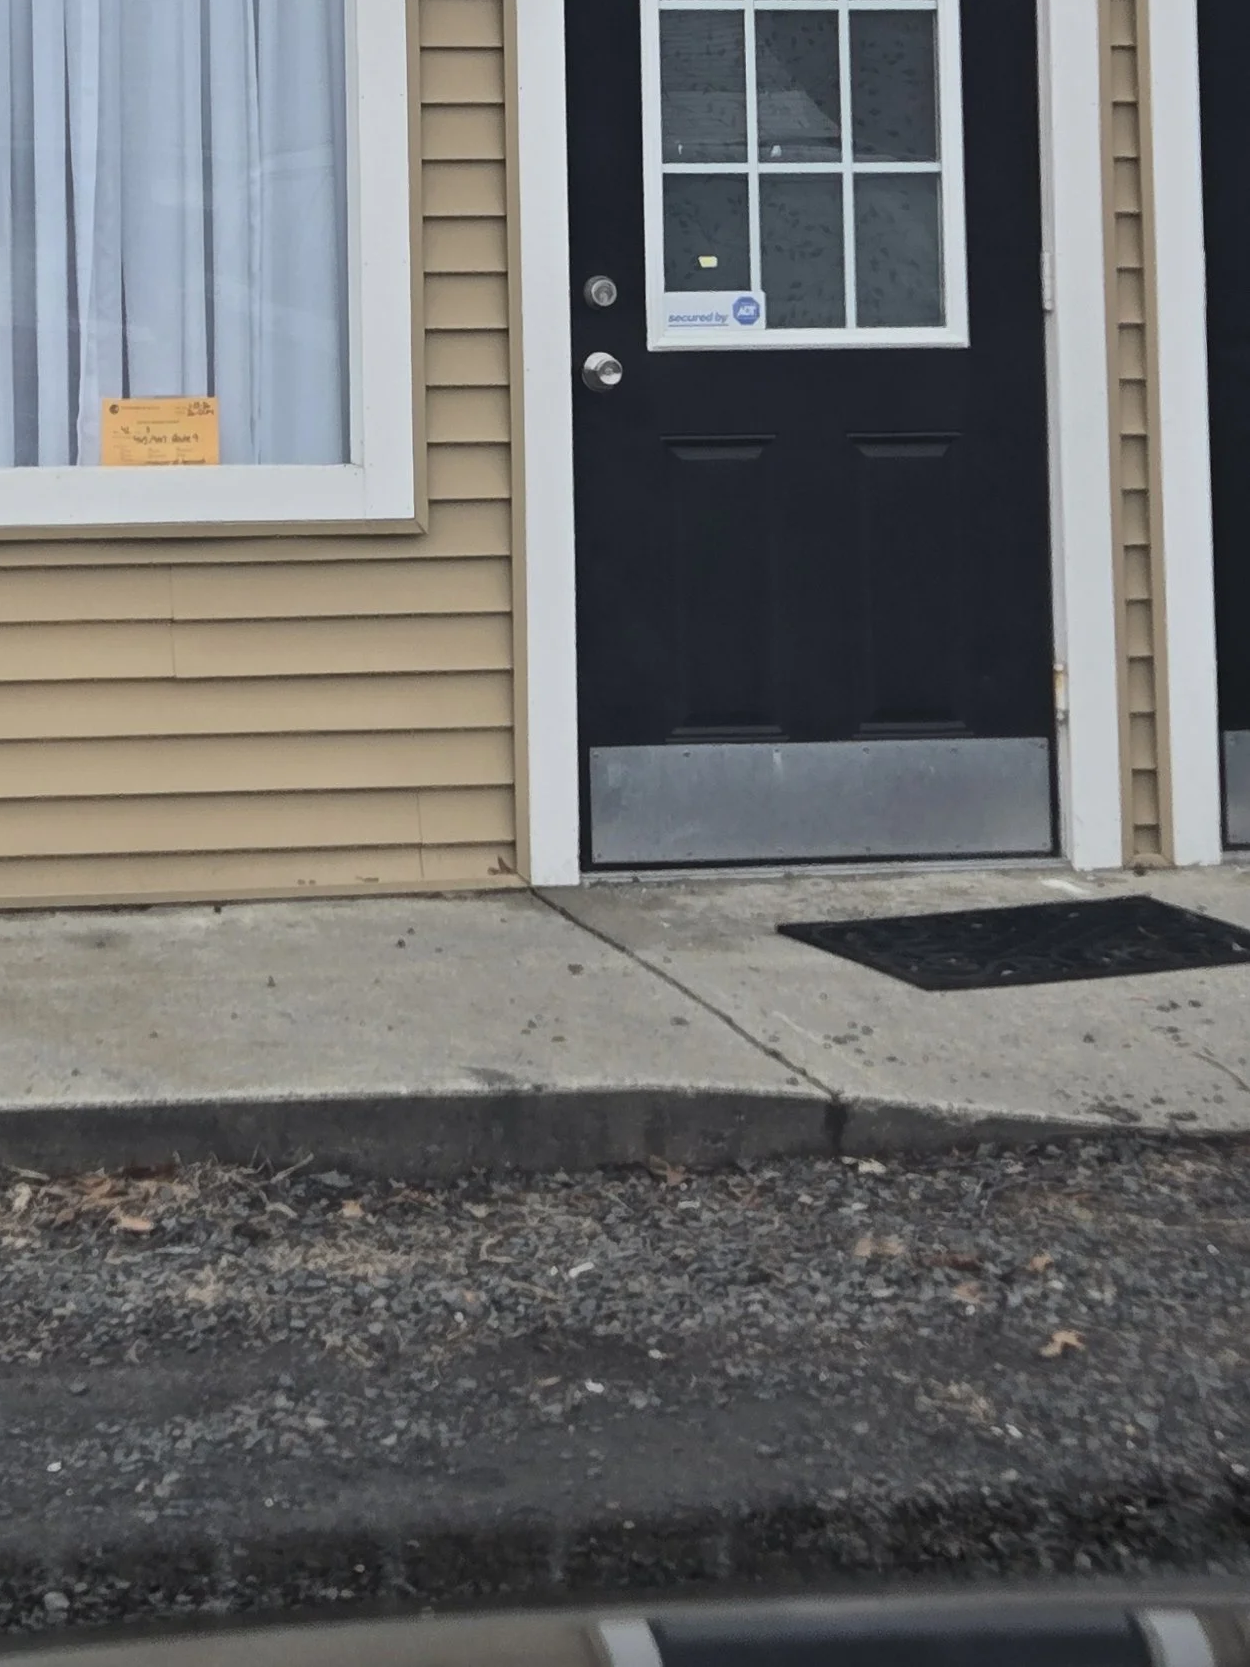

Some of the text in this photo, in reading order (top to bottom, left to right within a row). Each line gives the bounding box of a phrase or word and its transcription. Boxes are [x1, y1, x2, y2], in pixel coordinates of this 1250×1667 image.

[737, 305, 756, 316] ADT
[668, 312, 729, 323] secured by
